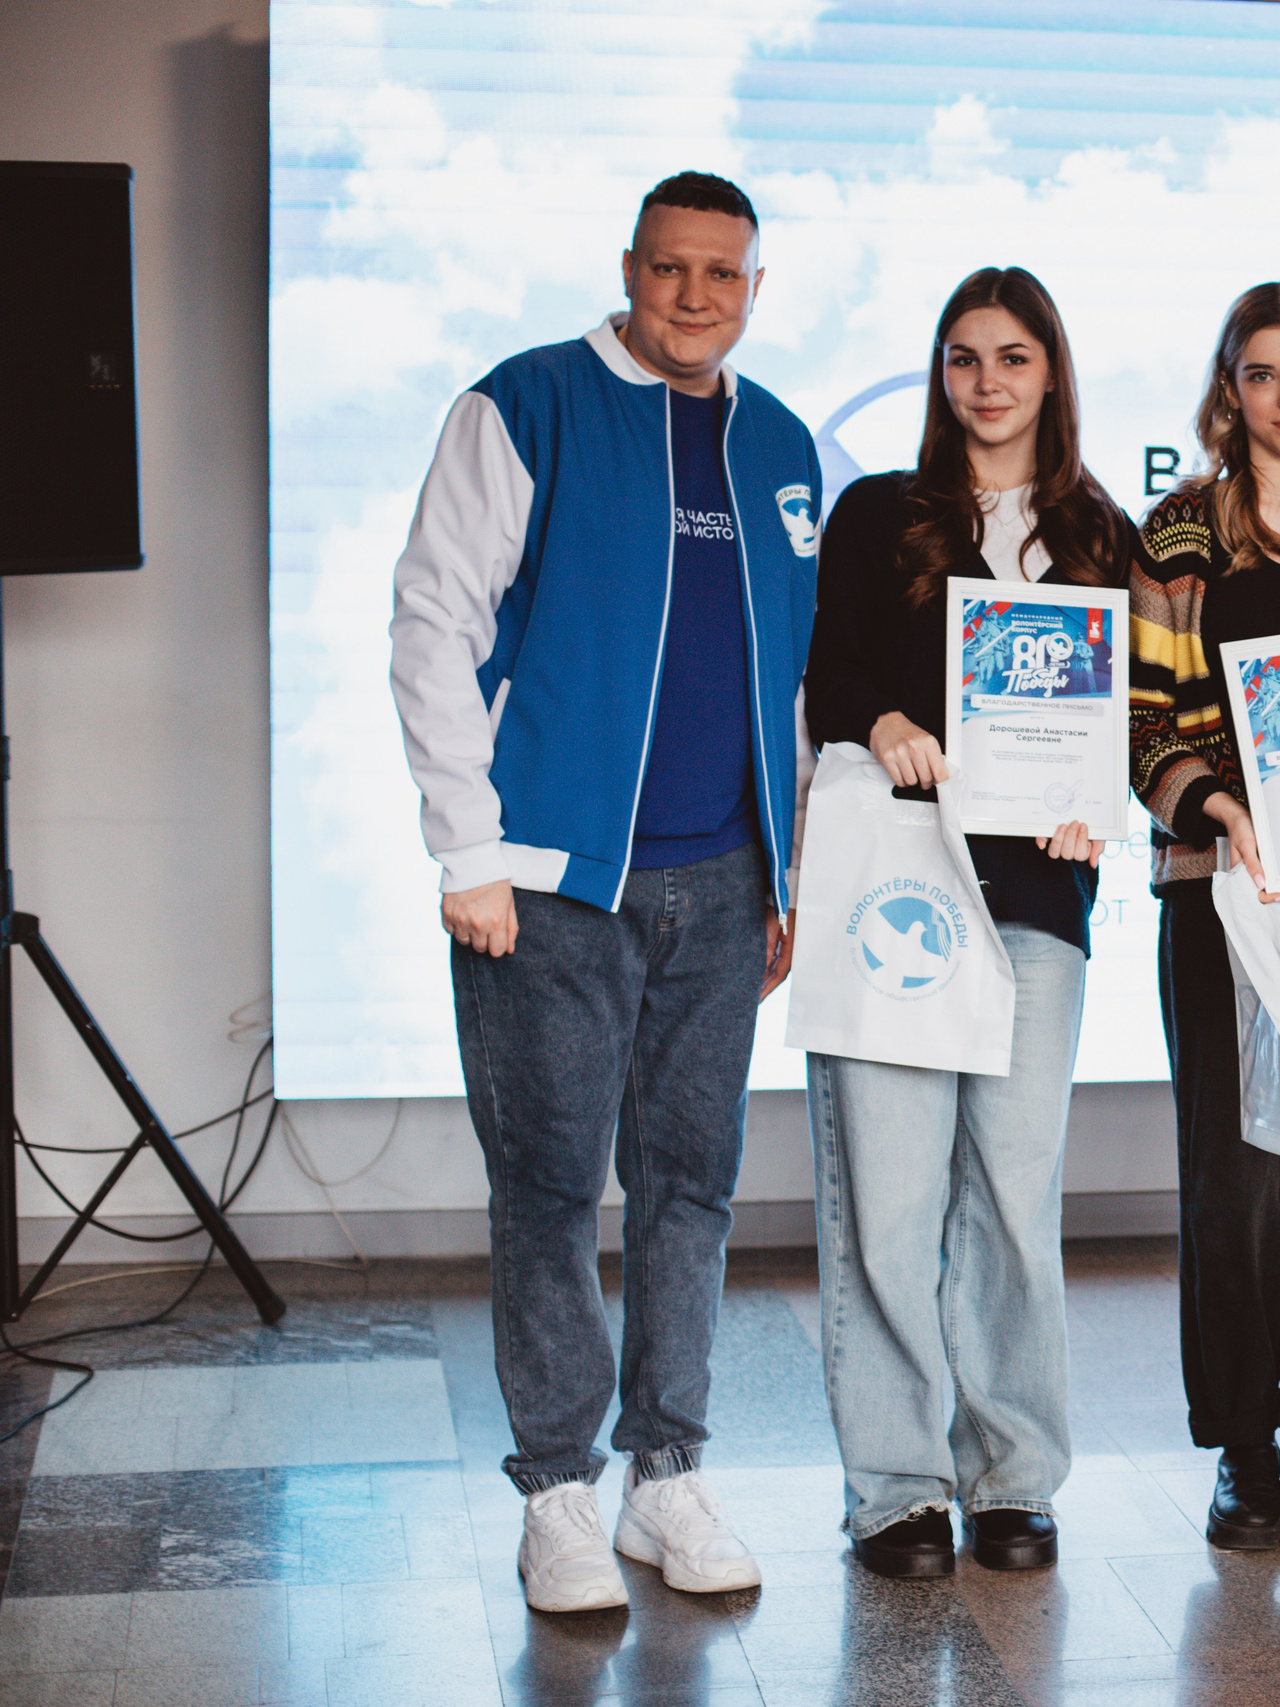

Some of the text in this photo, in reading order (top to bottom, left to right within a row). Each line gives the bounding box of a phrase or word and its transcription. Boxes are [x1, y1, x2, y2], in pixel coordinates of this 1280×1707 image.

[981, 698, 1093, 712] БЛАГОДАРСТВЕННОЕ ПИСЬМО
[989, 724, 1088, 737] Дорошевой Анастасии
[1016, 734, 1062, 744] Сергеевне
[846, 876, 968, 948] ВОЛОНТЁРЫ ПОБЕДЫ
